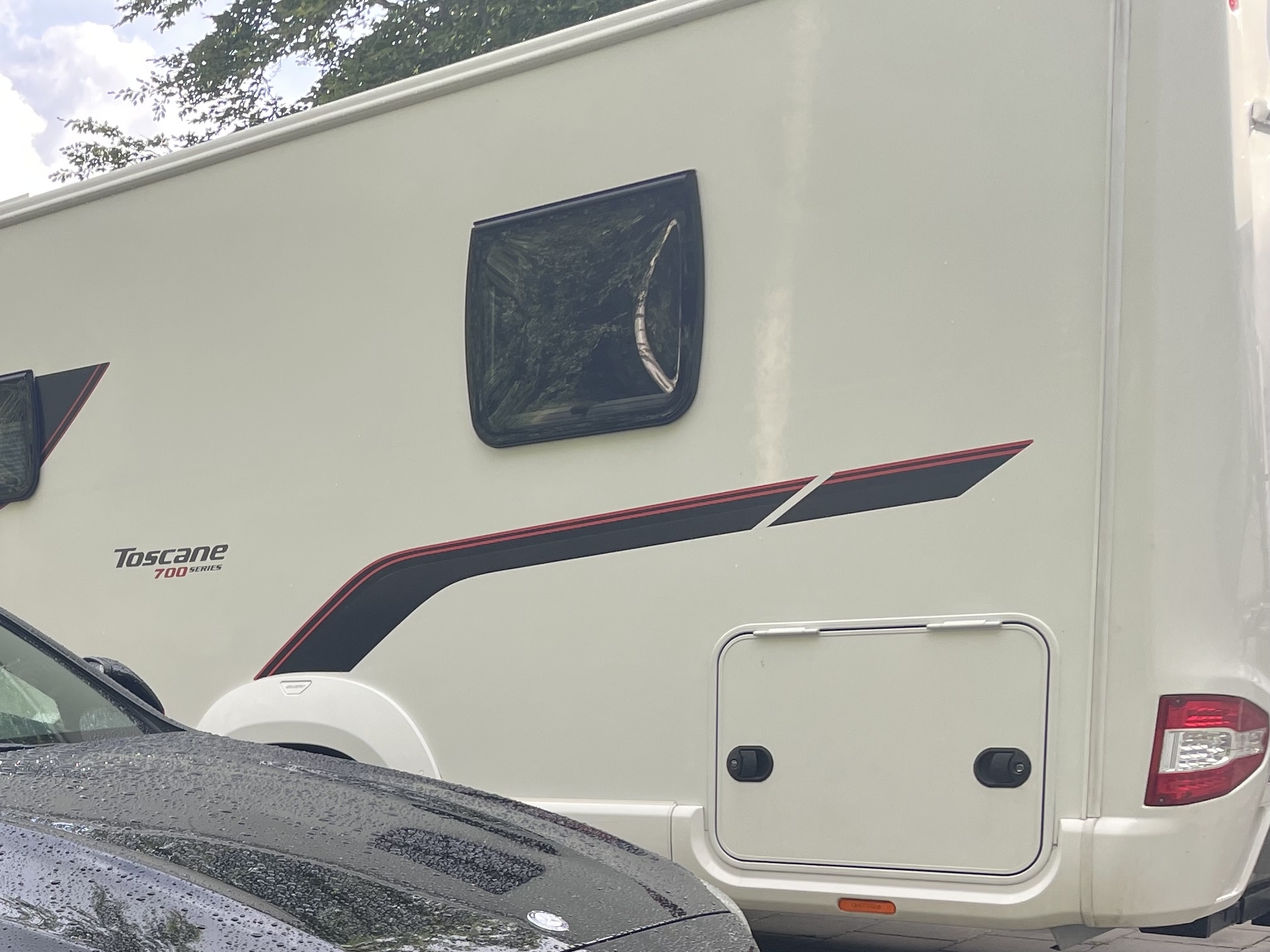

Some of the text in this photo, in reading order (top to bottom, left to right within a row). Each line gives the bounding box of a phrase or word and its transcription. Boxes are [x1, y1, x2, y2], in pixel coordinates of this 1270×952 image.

[113, 543, 229, 569] Toscane
[154, 564, 223, 580] 700 SERIES
